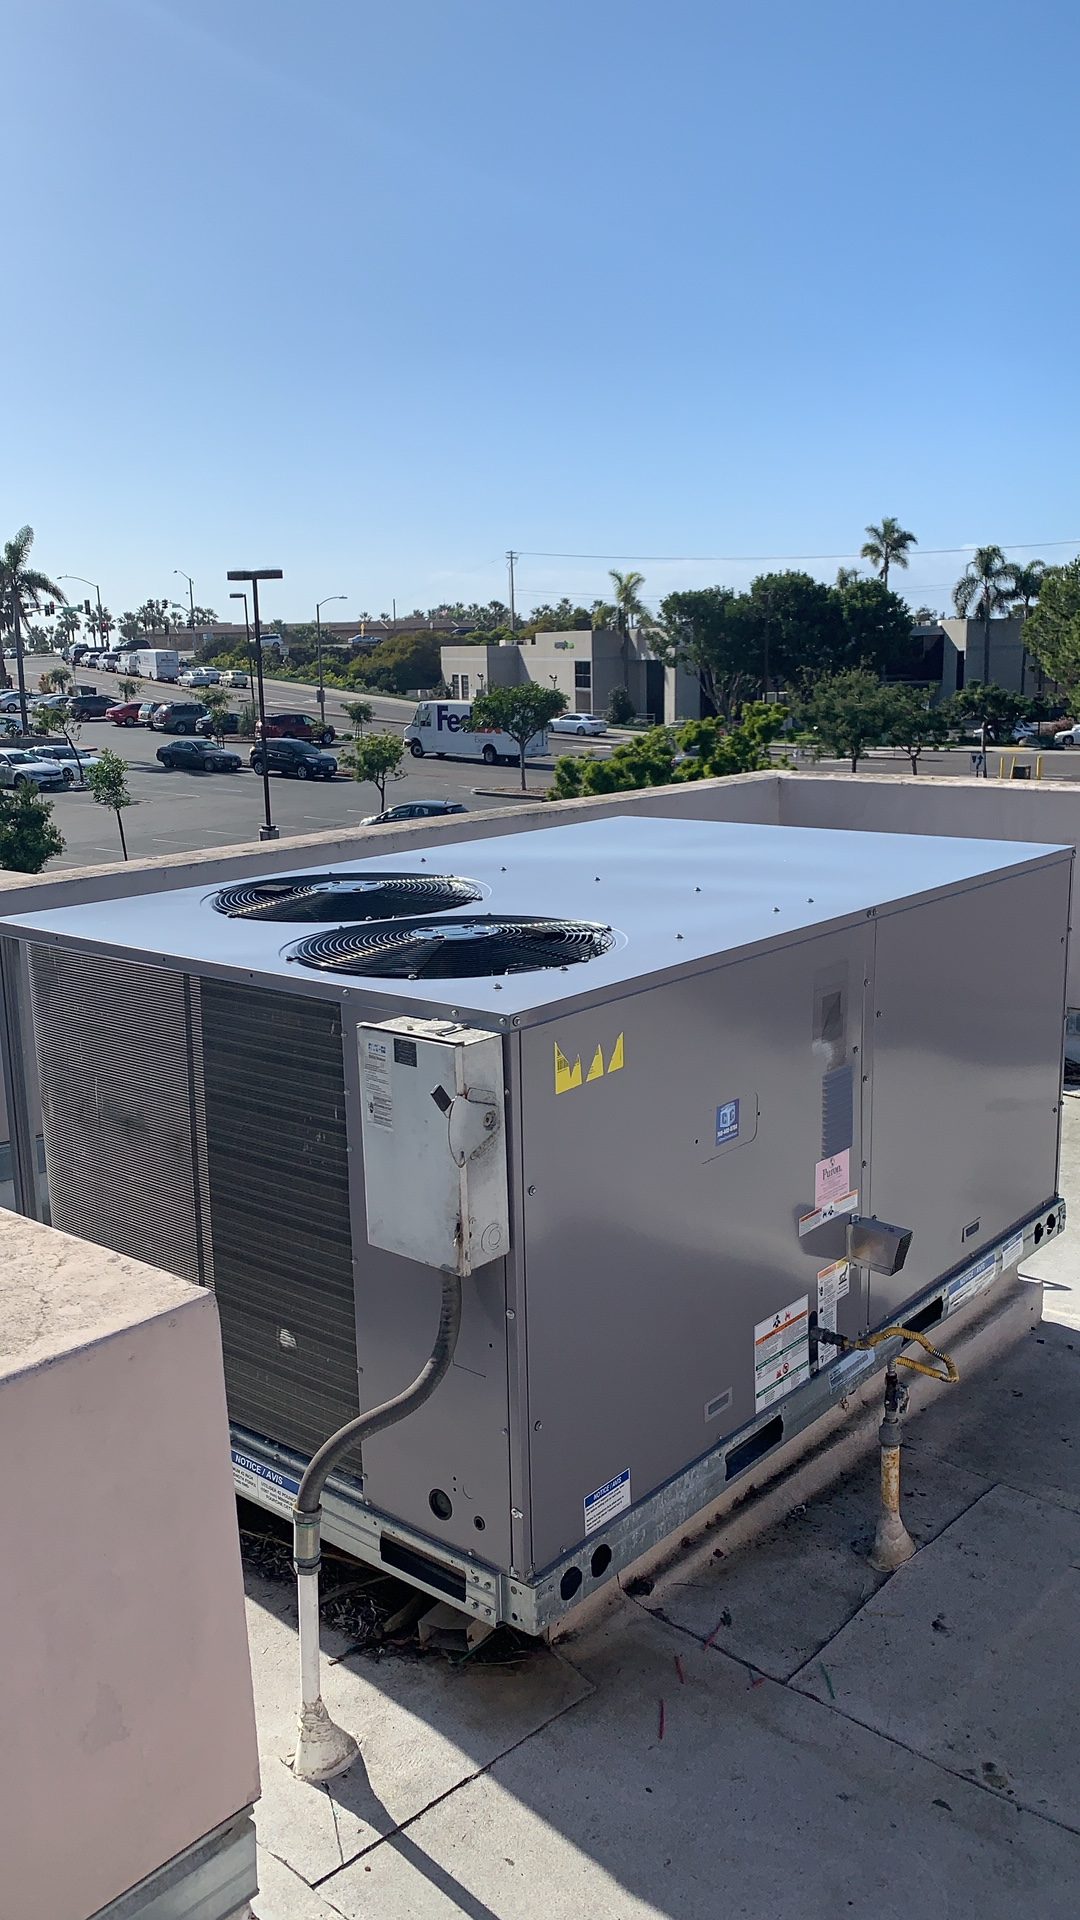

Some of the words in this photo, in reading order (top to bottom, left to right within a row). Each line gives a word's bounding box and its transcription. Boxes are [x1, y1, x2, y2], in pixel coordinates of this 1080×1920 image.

[235, 1454, 262, 1475] NOTICE
[261, 1468, 266, 1477] /
[265, 1470, 284, 1485] AVIS
[593, 1485, 610, 1501] NOTICE
[612, 1476, 622, 1487] AVIS
